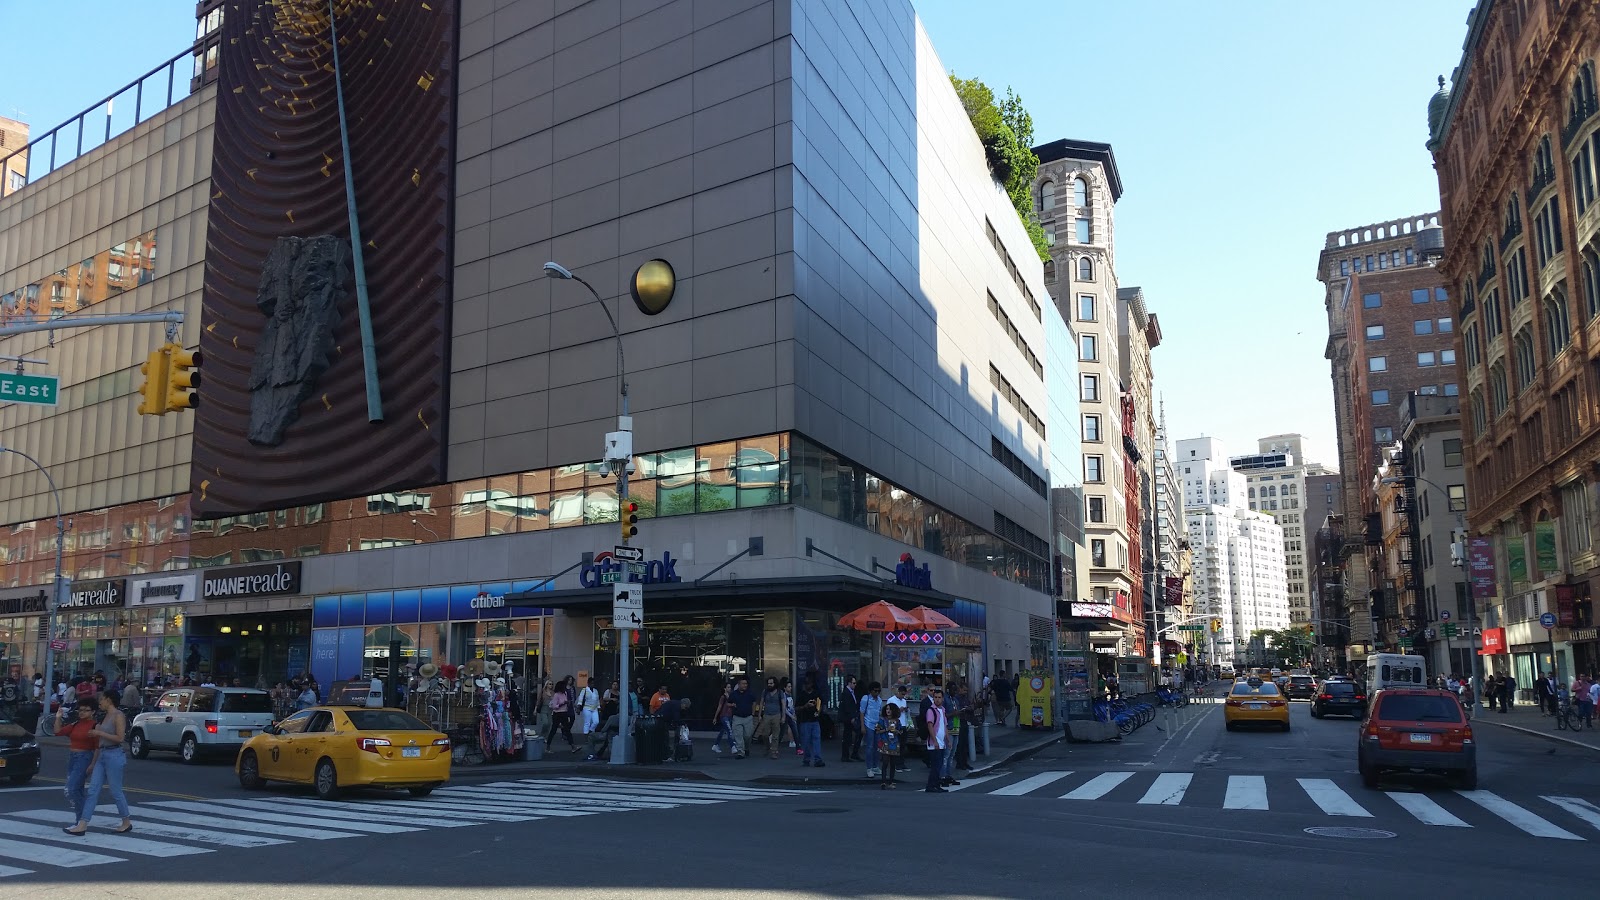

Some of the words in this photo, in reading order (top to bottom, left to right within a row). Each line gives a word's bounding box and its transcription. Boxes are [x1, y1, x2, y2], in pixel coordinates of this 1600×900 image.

[1, 380, 49, 397] East
[580, 551, 682, 588] citnk
[608, 574, 614, 582] 14
[140, 581, 184, 603] pharmacy
[470, 592, 505, 608] citiban
[317, 632, 337, 645] Make
[339, 631, 346, 644] it
